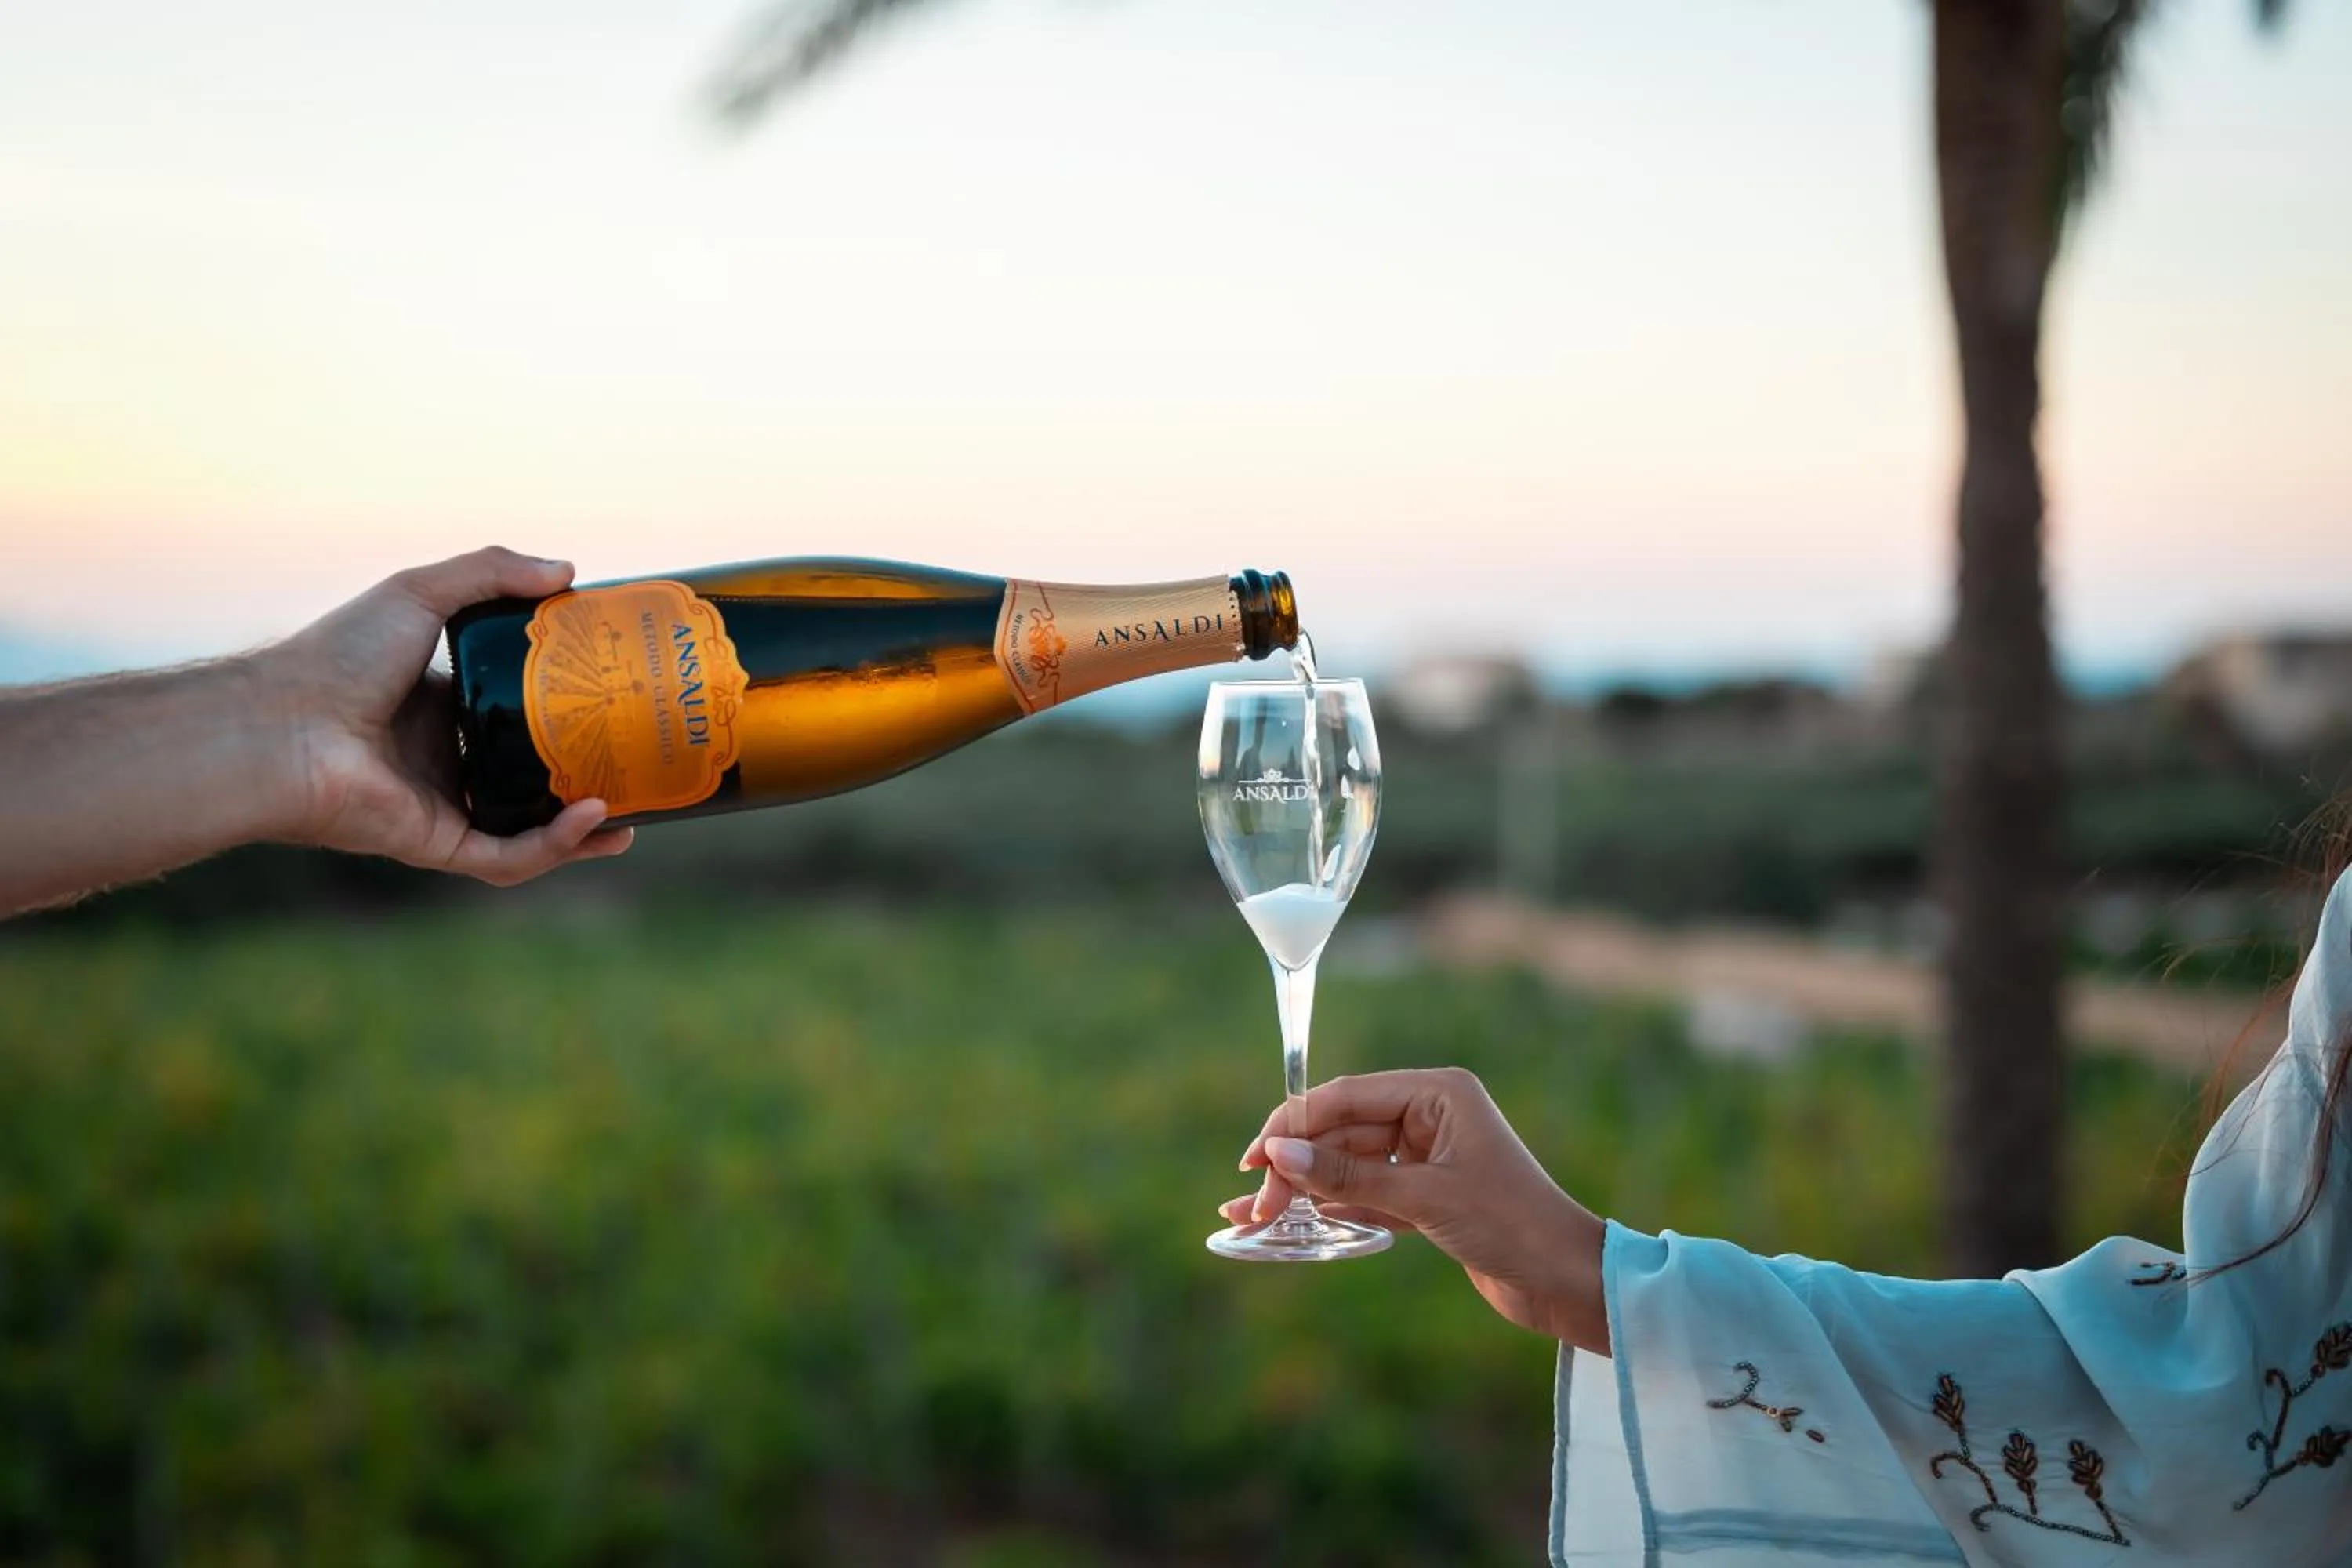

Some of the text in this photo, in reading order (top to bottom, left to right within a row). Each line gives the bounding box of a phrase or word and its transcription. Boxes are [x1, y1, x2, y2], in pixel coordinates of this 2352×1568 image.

[641, 611, 675, 765] METODO CLASSICO
[671, 623, 710, 746] ANSALDI
[1094, 613, 1223, 647] ANSALDI
